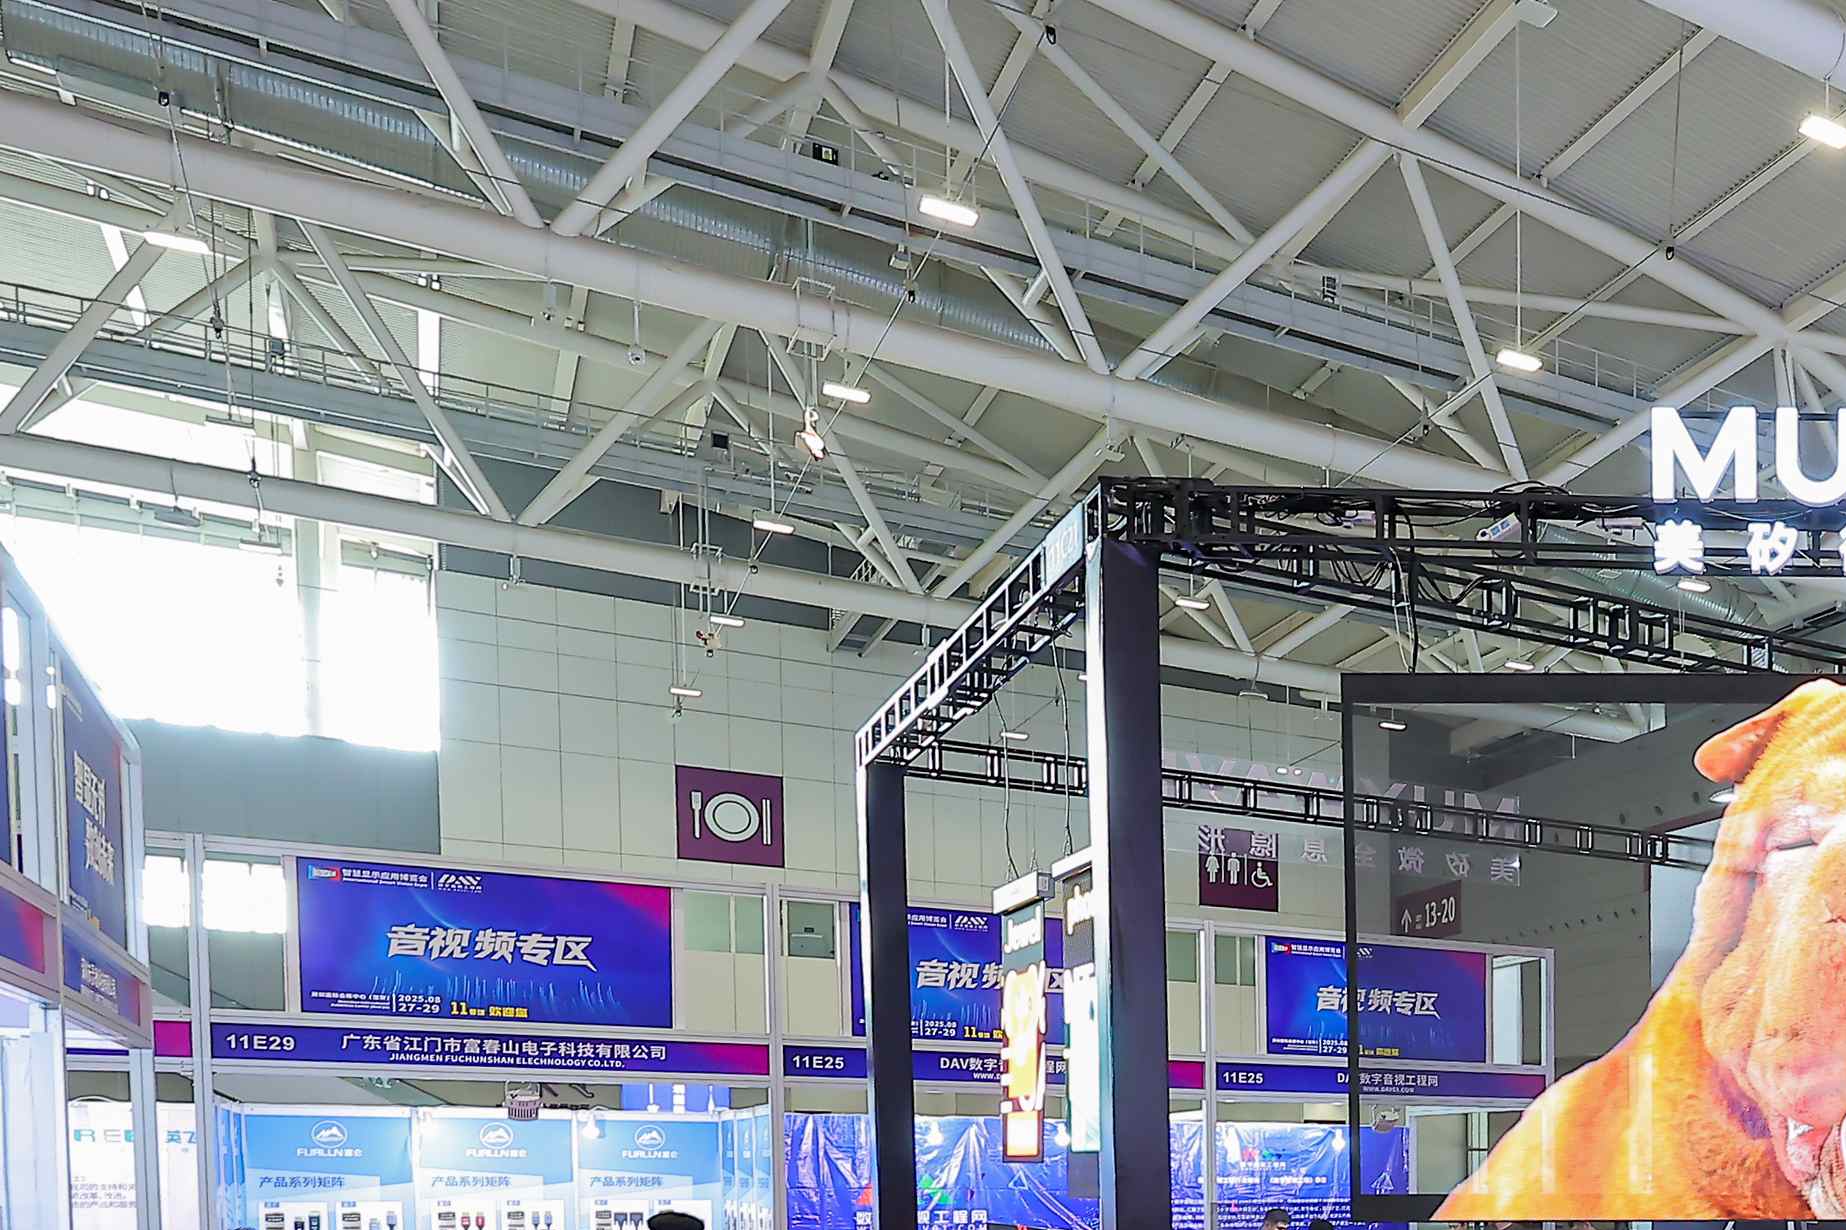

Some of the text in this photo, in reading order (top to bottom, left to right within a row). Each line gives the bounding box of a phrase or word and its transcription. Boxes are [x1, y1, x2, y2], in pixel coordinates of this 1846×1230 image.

[1424, 896, 1456, 929] 13-20
[387, 923, 598, 972] 音视频专区
[916, 959, 1066, 993] 音视频区
[398, 994, 441, 1004] 2025.08
[1315, 985, 1441, 1020] 音视频专区
[398, 1003, 441, 1014] 27-29
[924, 1027, 956, 1037] 27-29
[226, 1034, 295, 1052] 11E29
[341, 1033, 667, 1061] 广东省江门市富春山电子科技有限公司
[1322, 1045, 1348, 1055] 27-29
[389, 1052, 443, 1064] JIANGMEN
[444, 1054, 515, 1066] FUCHUNSHAN
[792, 1055, 844, 1070] 11E25
[1222, 1071, 1264, 1084] 11E25
[258, 1175, 345, 1189] 产品系列矩阵
[431, 1175, 512, 1188] 产品系列矩阵
[589, 1176, 664, 1188] 产品系列矩阵
[856, 1210, 988, 1227] 数视工程网
